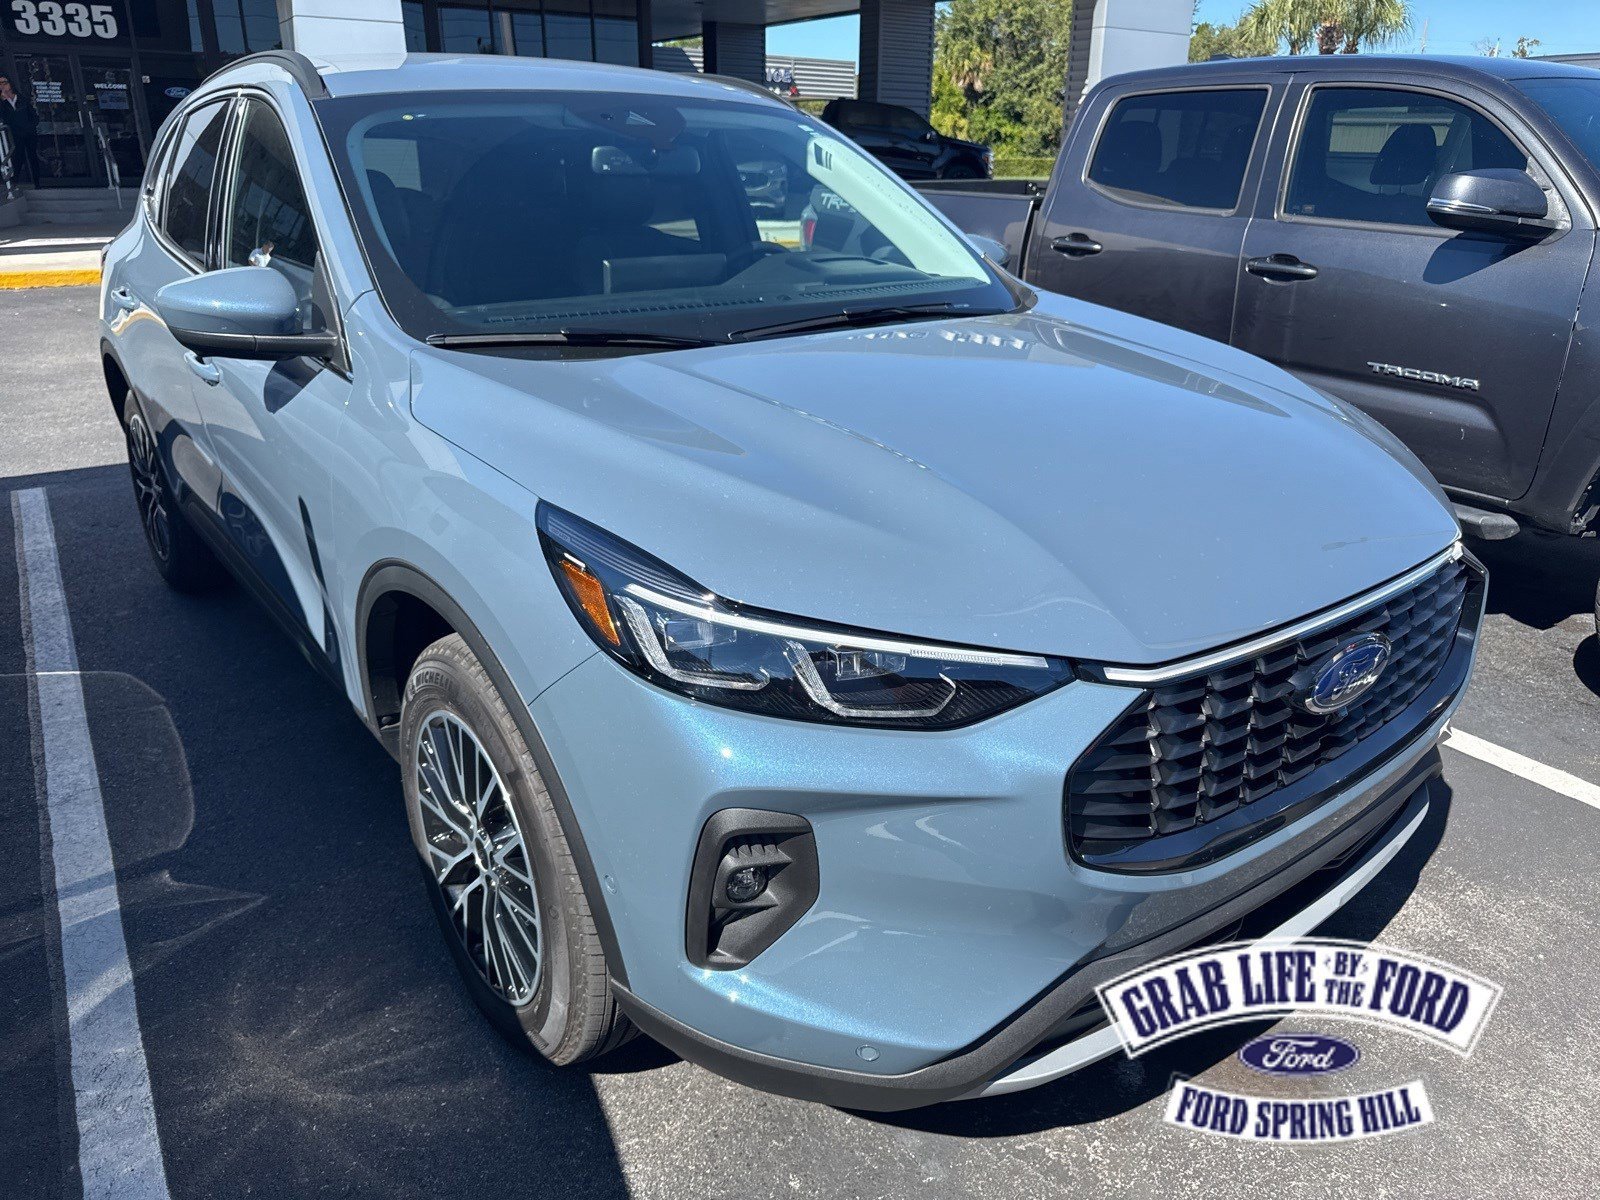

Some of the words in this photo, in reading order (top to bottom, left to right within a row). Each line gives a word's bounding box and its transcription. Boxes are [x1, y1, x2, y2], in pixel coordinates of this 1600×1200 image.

[11, 0, 118, 39] 3335
[1366, 361, 1481, 392] TACOMA
[1331, 649, 1384, 701] Ford
